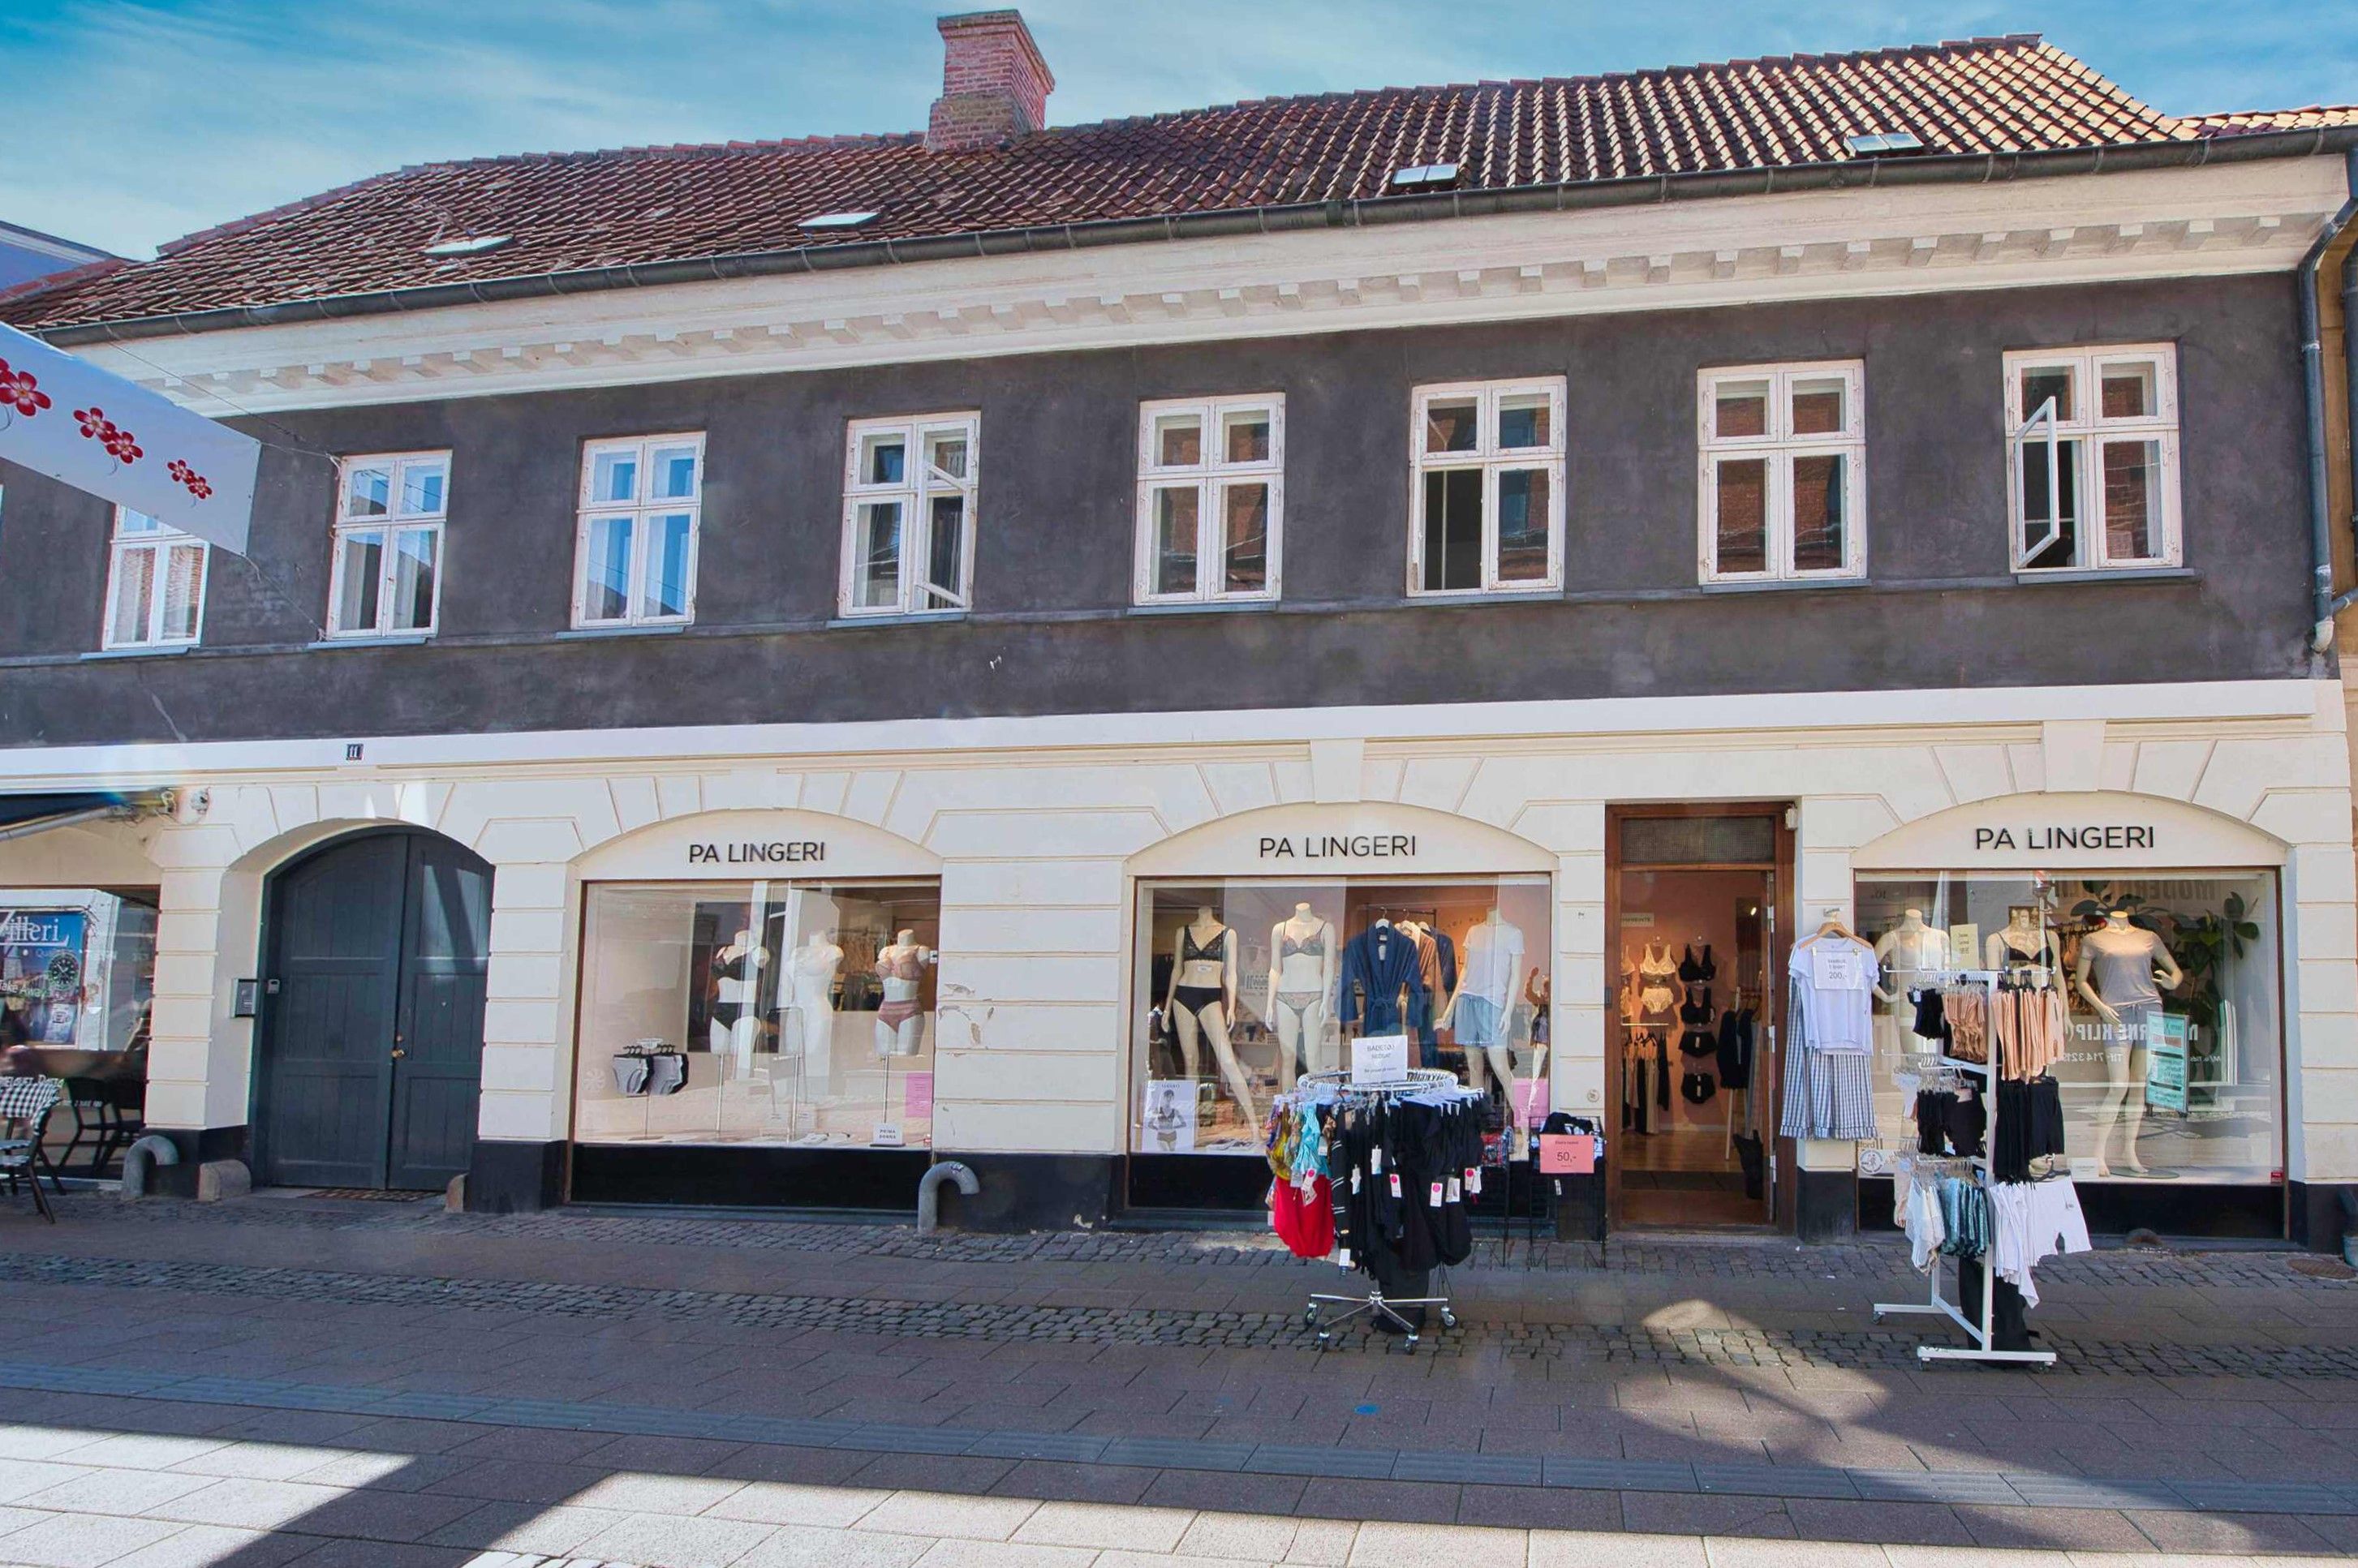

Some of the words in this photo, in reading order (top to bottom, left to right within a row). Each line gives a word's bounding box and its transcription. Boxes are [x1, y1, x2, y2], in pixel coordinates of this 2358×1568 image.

[1259, 837, 1294, 857] PA
[1306, 836, 1415, 857] LINGERI
[1976, 827, 2016, 849] PA
[2028, 826, 2154, 848] LINGERI
[688, 843, 720, 862] PA
[728, 841, 825, 861] LINGERI
[1557, 1152, 1577, 1162] 50,-
